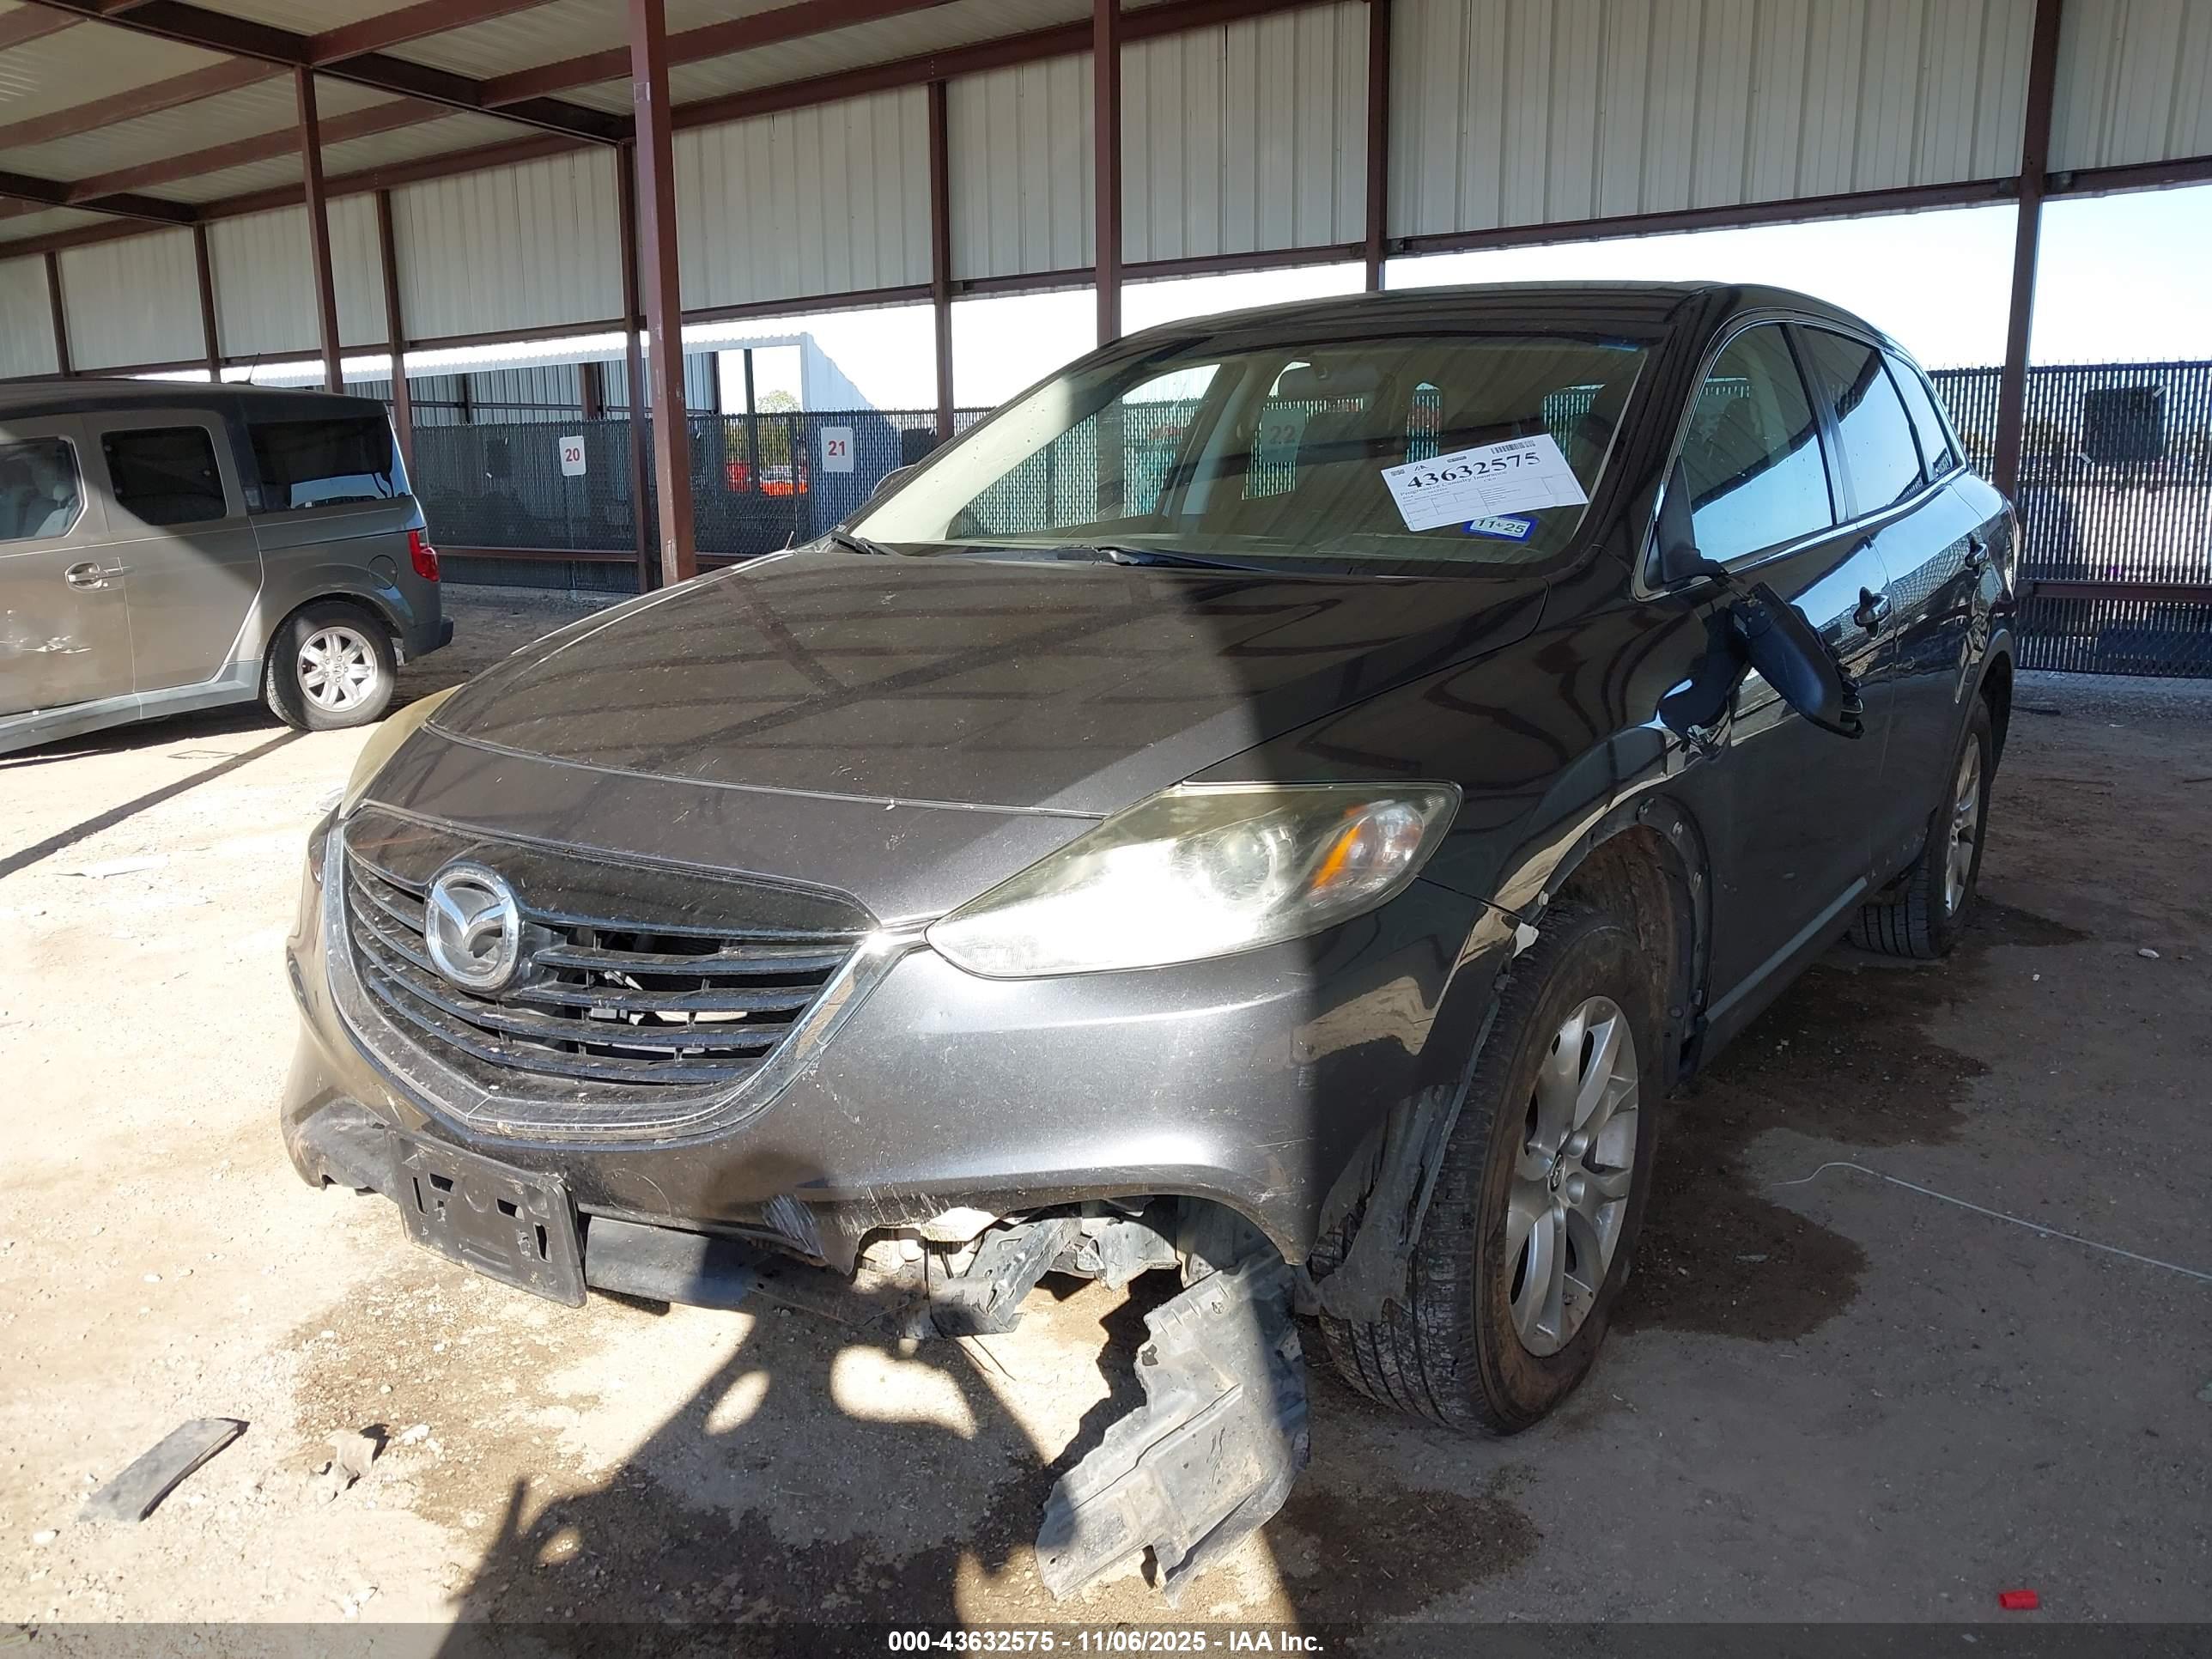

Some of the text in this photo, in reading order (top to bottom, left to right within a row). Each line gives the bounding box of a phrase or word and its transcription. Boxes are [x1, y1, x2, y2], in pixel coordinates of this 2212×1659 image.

[1270, 425, 1295, 444] 22
[565, 447, 580, 462] 20
[828, 441, 845, 456] 21
[1407, 452, 1540, 489] 43632575
